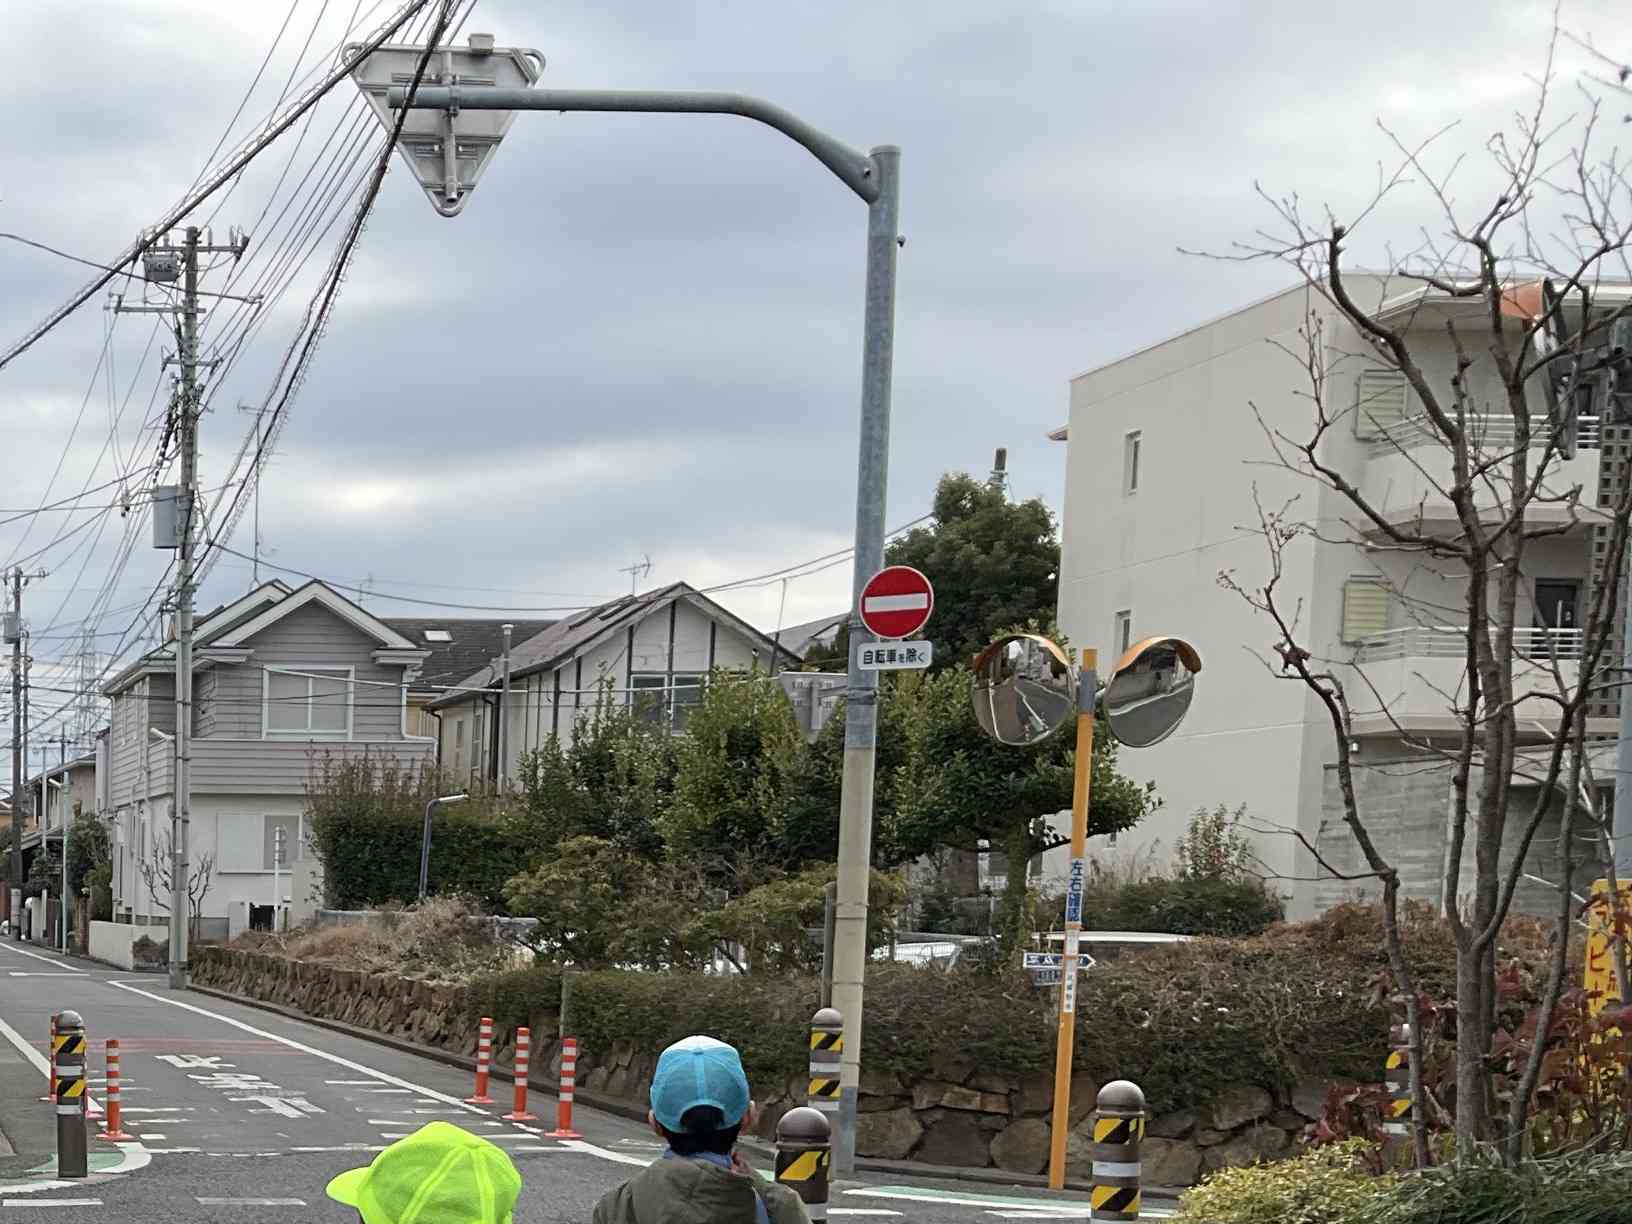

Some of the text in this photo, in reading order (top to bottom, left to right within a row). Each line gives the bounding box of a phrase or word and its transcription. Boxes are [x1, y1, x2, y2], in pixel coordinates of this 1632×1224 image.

[863, 647, 925, 665] 自転車を除く
